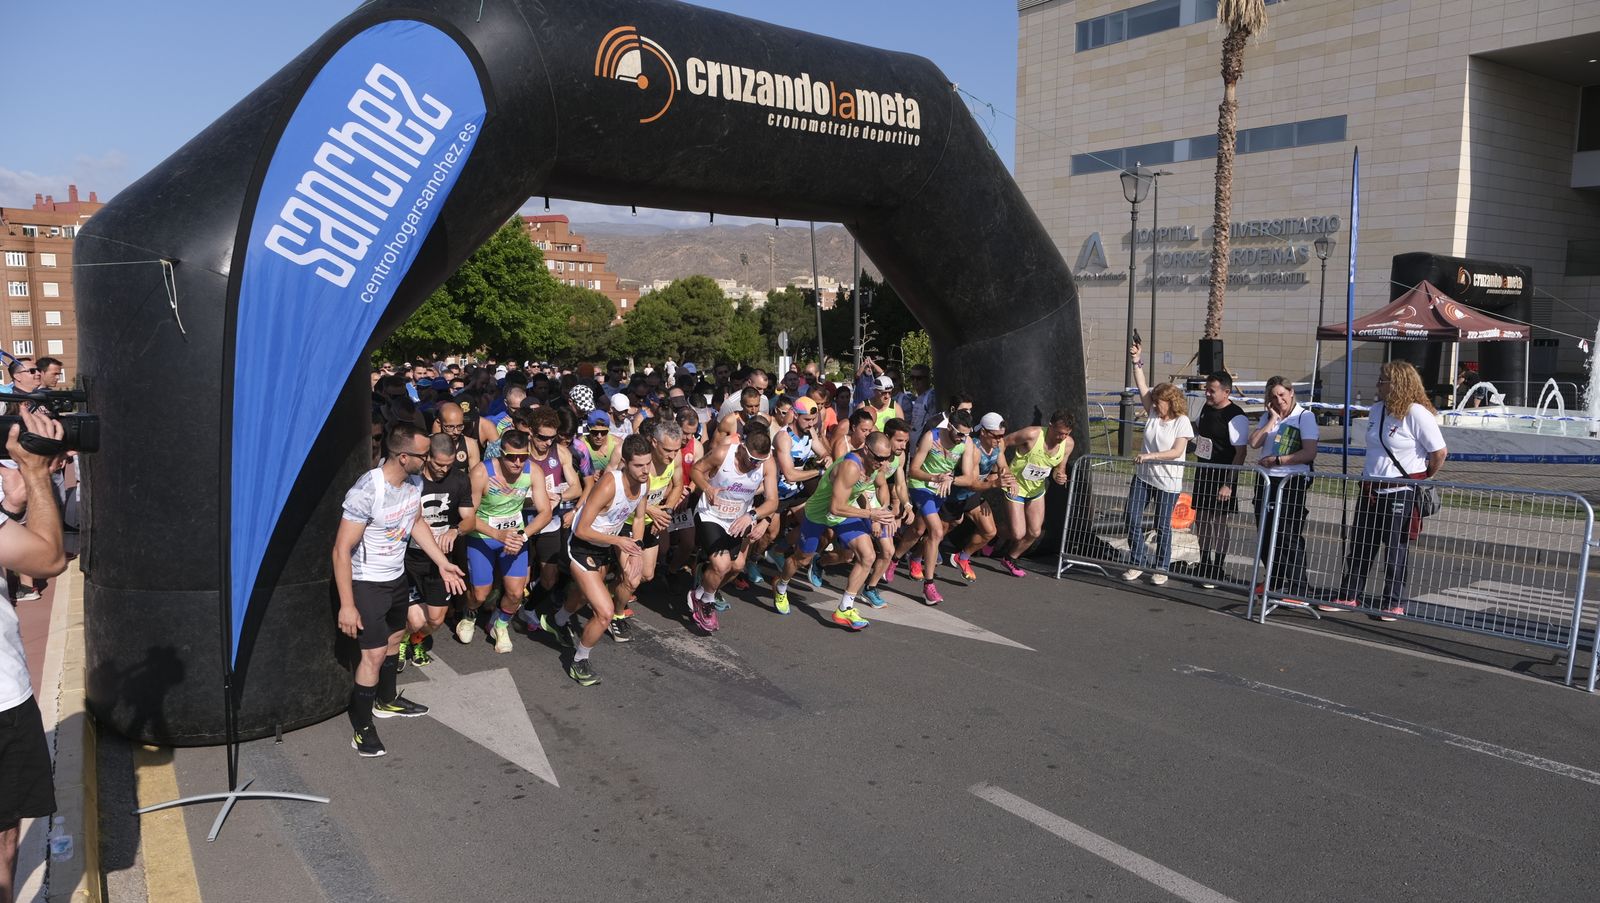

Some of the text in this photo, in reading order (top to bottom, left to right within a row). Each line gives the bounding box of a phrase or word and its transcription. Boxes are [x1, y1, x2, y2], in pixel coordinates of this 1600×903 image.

[686, 57, 921, 130] cruzandolameta
[767, 112, 921, 147] cronometraje deportivo
[360, 121, 477, 304] centrohogarsanchez.es
[1130, 225, 1198, 244] OSPITAL
[1030, 469, 1046, 477] 127
[496, 520, 517, 530] 159
